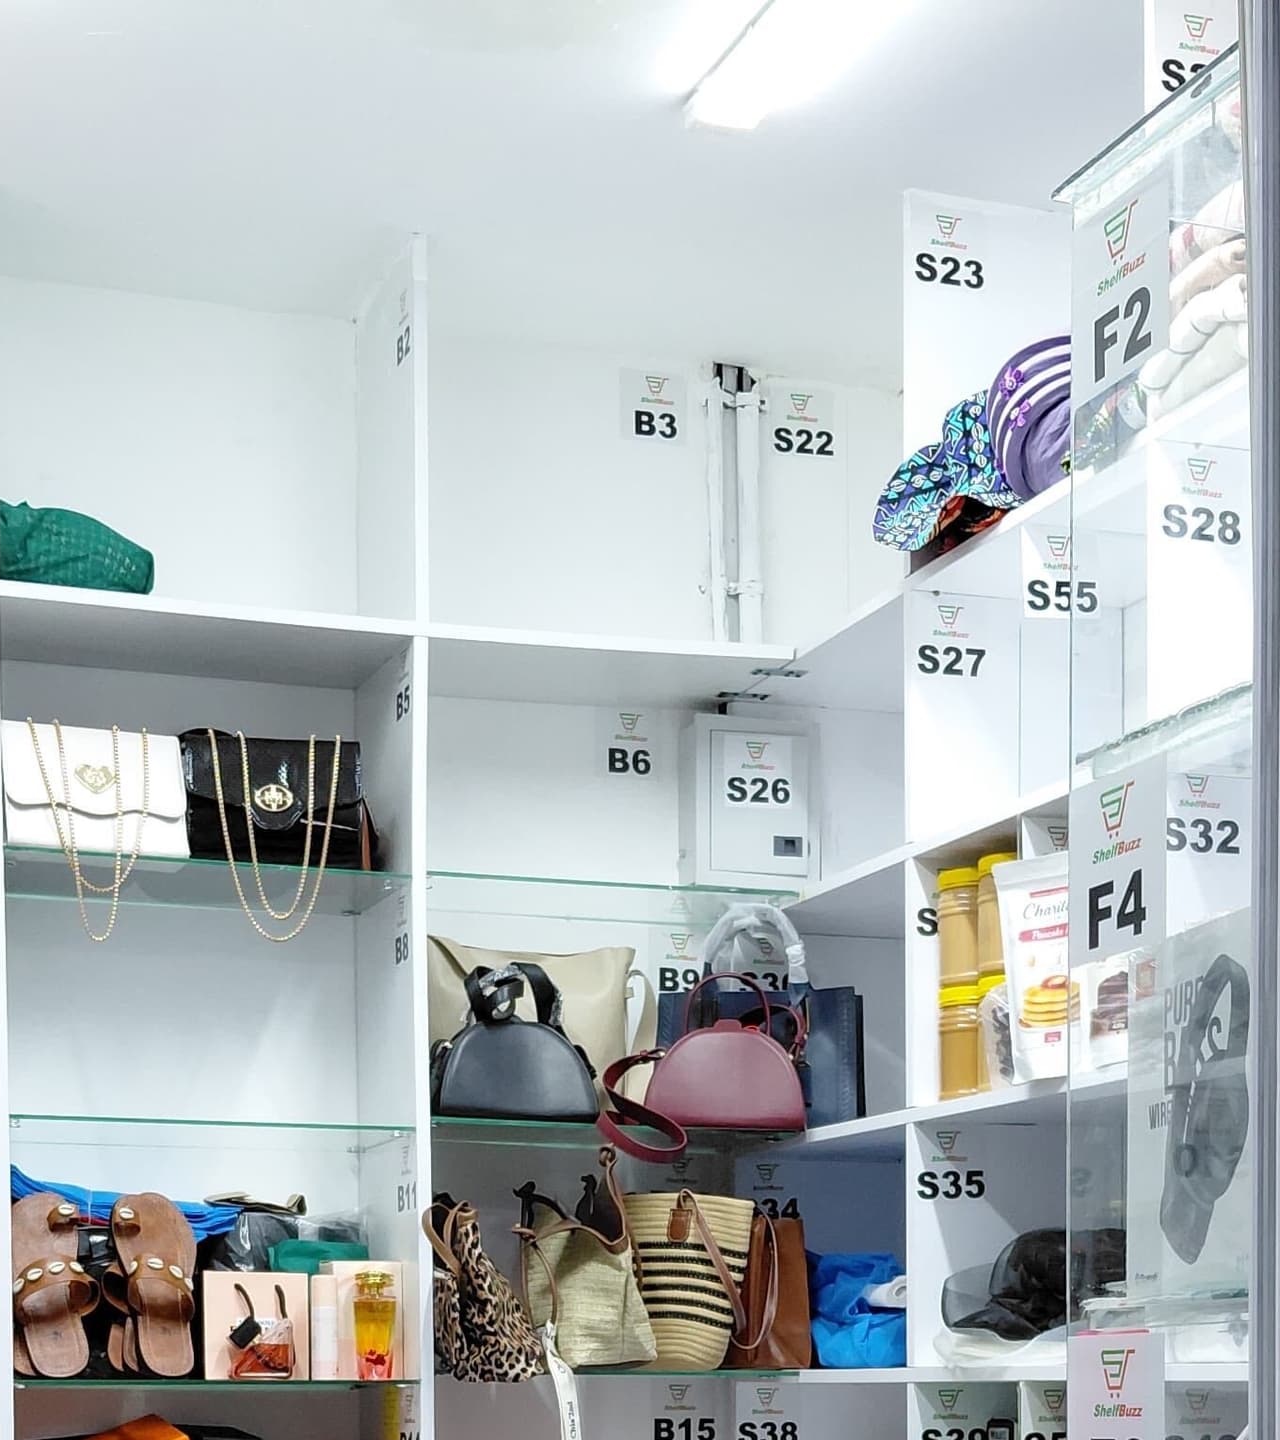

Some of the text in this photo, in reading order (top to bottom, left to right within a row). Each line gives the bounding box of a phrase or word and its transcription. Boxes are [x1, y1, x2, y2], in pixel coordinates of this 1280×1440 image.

[914, 252, 985, 289] S23
[1096, 252, 1146, 297] ShelfBuzz
[396, 325, 412, 367] B2
[1093, 286, 1152, 384] F2
[633, 410, 678, 439] B3
[773, 427, 834, 457] S22
[1162, 504, 1241, 545] S28
[1026, 579, 1098, 614] S55
[917, 645, 986, 677] S27
[396, 681, 411, 723] B5
[607, 747, 651, 776] B6
[727, 776, 791, 805] S26
[1092, 836, 1143, 865] ShelfBuzz
[1166, 818, 1240, 855] S32
[1089, 868, 1147, 951] F4
[394, 934, 410, 965] B8
[659, 967, 700, 992] B9
[397, 1183, 418, 1212] B11
[917, 1170, 986, 1200] S35
[1094, 1404, 1143, 1418] ShelfBuzz
